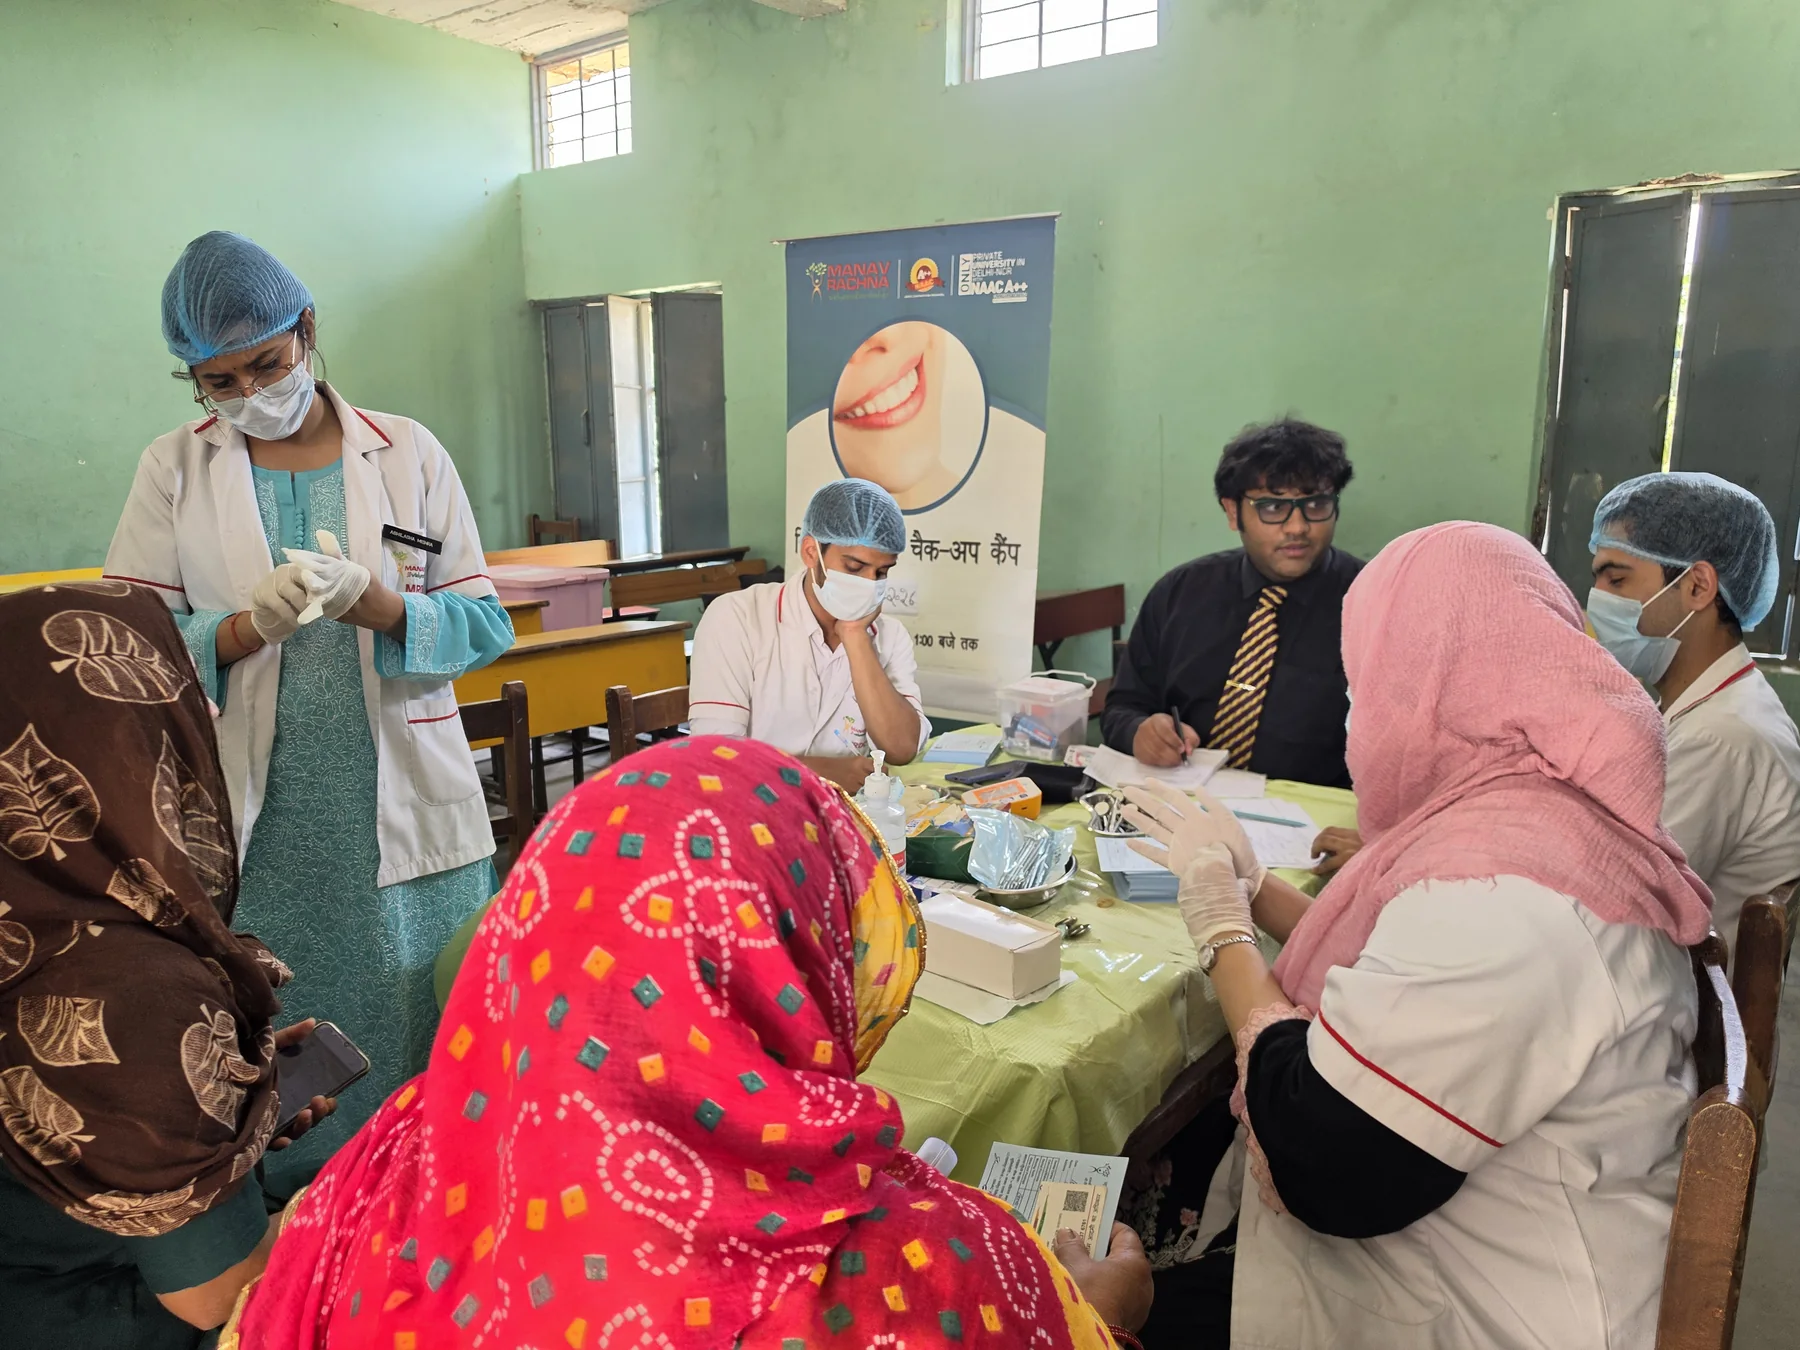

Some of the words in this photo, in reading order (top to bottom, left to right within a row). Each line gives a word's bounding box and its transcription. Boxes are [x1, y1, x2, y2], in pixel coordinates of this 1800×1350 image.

[827, 261, 891, 277] MANAV
[961, 258, 971, 293] ONLY
[827, 275, 889, 291] RACHNA
[973, 280, 1004, 295] NAAC
[1004, 279, 1028, 293] A++
[910, 530, 981, 563] चैक-अप
[990, 533, 1021, 566] कैंप
[938, 631, 956, 648] बजे
[960, 637, 979, 651] तक
